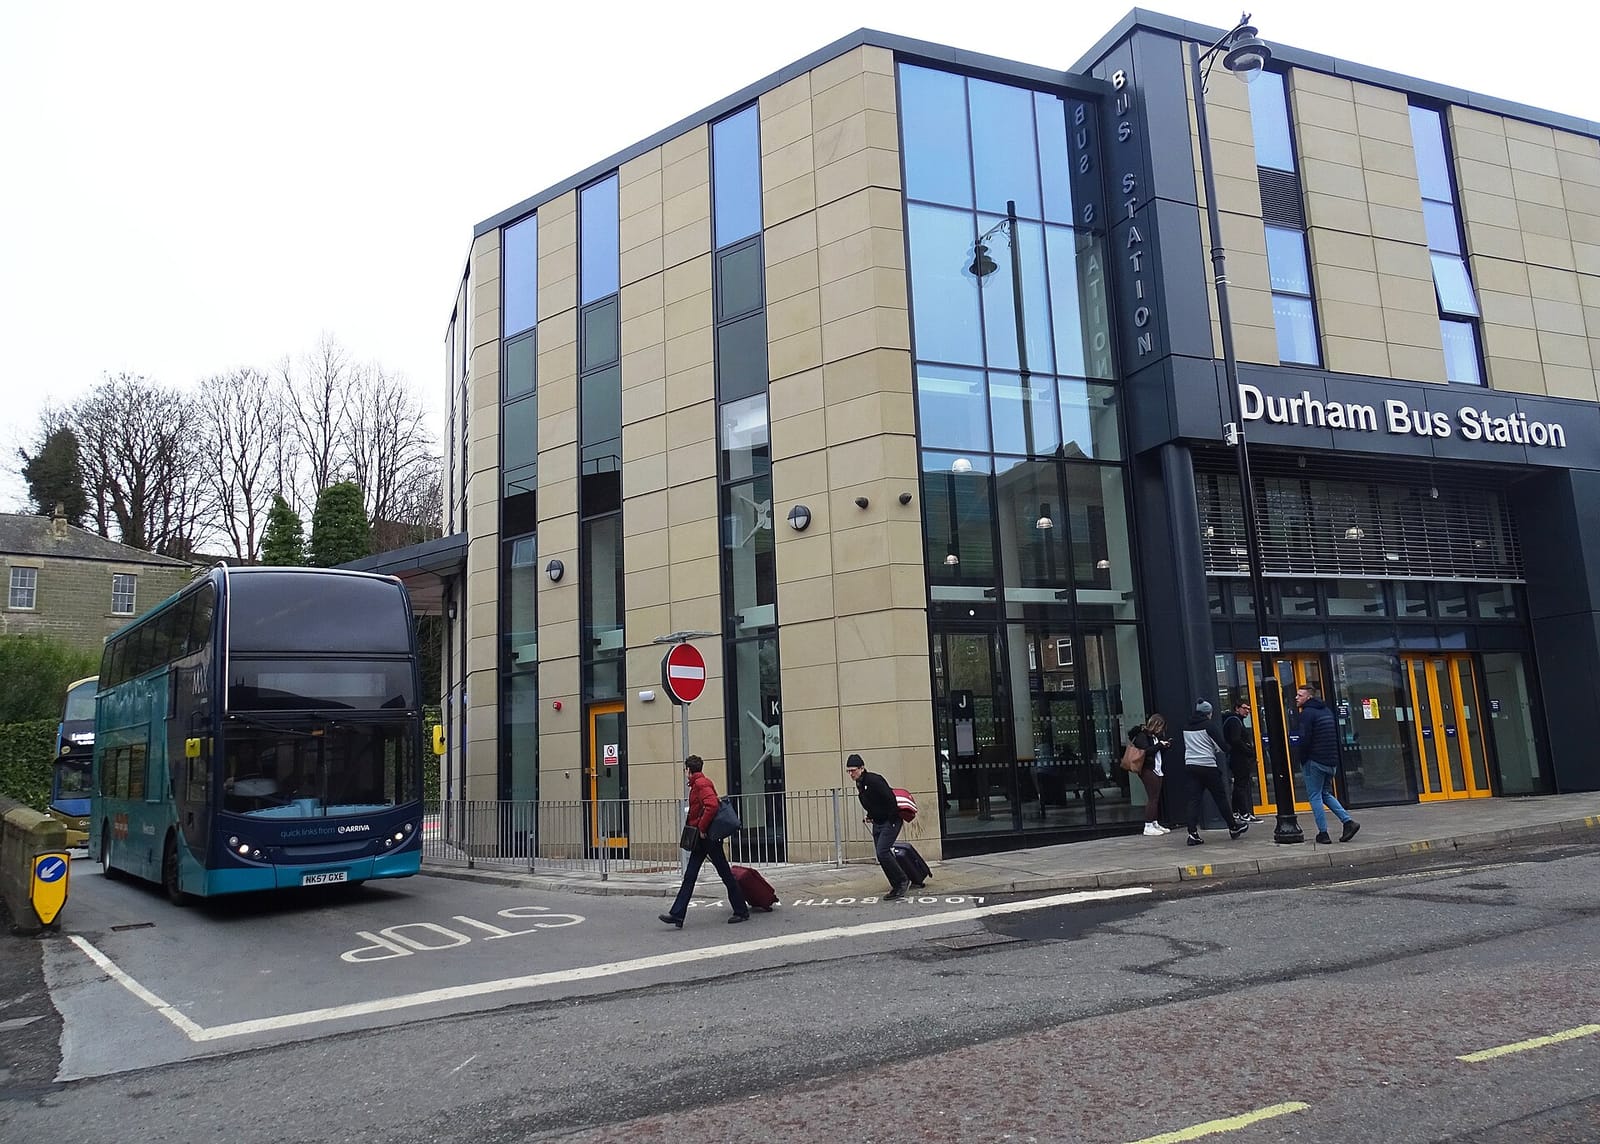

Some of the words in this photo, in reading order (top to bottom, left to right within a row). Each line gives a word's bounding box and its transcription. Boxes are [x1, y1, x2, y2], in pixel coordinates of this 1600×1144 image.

[1112, 69, 1131, 143] BUS
[1122, 172, 1153, 356] STATION
[1238, 383, 1377, 431] Durham
[1385, 399, 1451, 438] Bus
[1457, 406, 1566, 447] Station
[771, 700, 780, 715] K
[958, 694, 967, 708] J
[280, 828, 301, 839] quick
[301, 827, 318, 836] links
[319, 826, 336, 835] from
[345, 824, 370, 833] ARRIVA
[305, 874, 328, 885] NK57
[328, 872, 344, 882] GXE
[792, 896, 879, 907] BOTH
[340, 906, 586, 963] STOP
